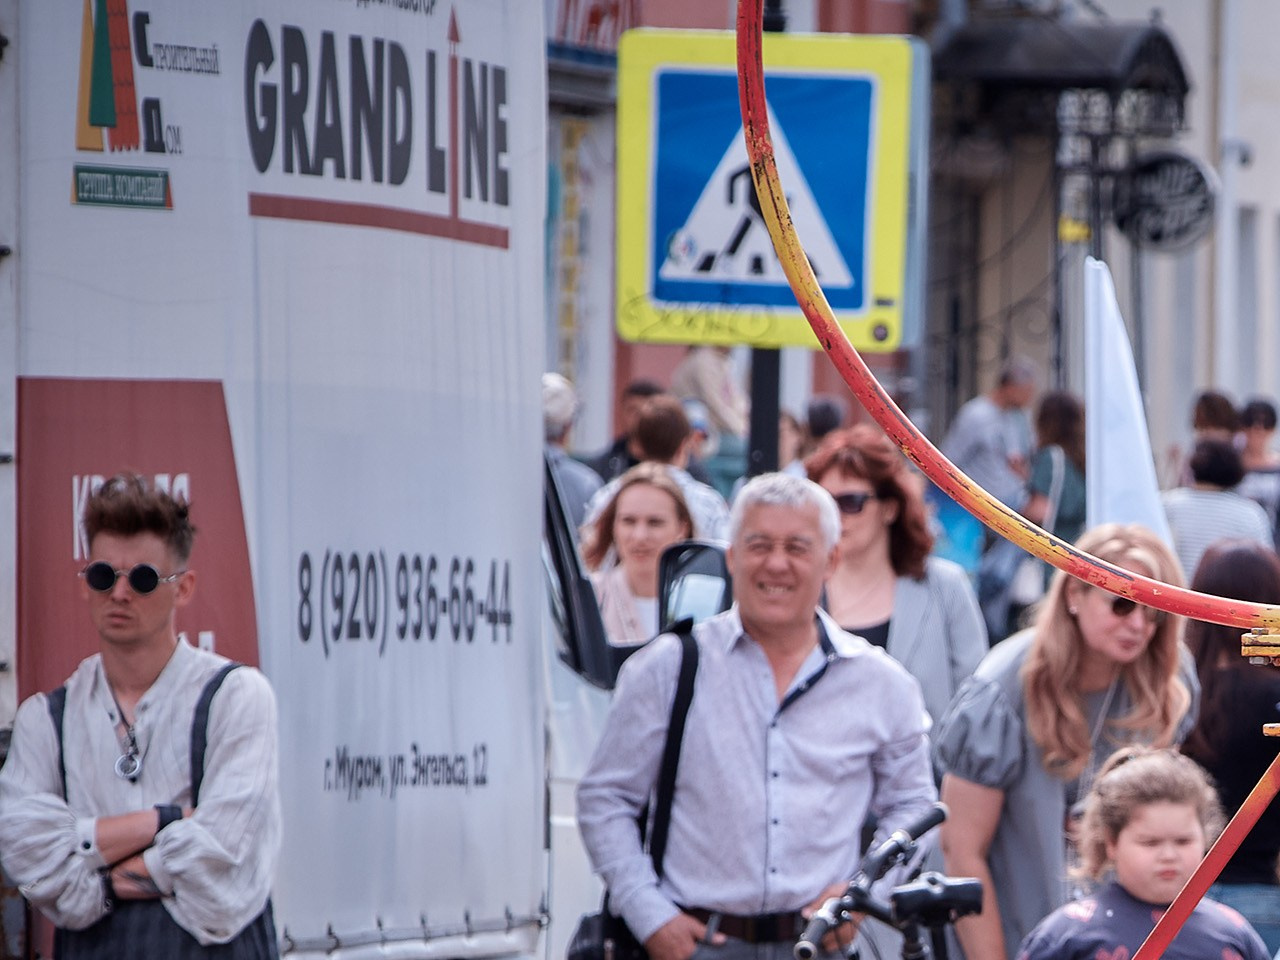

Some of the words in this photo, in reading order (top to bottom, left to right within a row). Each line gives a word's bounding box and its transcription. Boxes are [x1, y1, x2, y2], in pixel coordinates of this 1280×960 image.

[244, 17, 414, 187] GRAND
[425, 44, 510, 208] LINE
[298, 551, 313, 643] 8
[320, 548, 388, 660] (920)
[396, 552, 513, 645] 936-66-44
[335, 744, 386, 801] Муром,
[388, 754, 408, 799] ул.
[472, 742, 488, 786] 12
